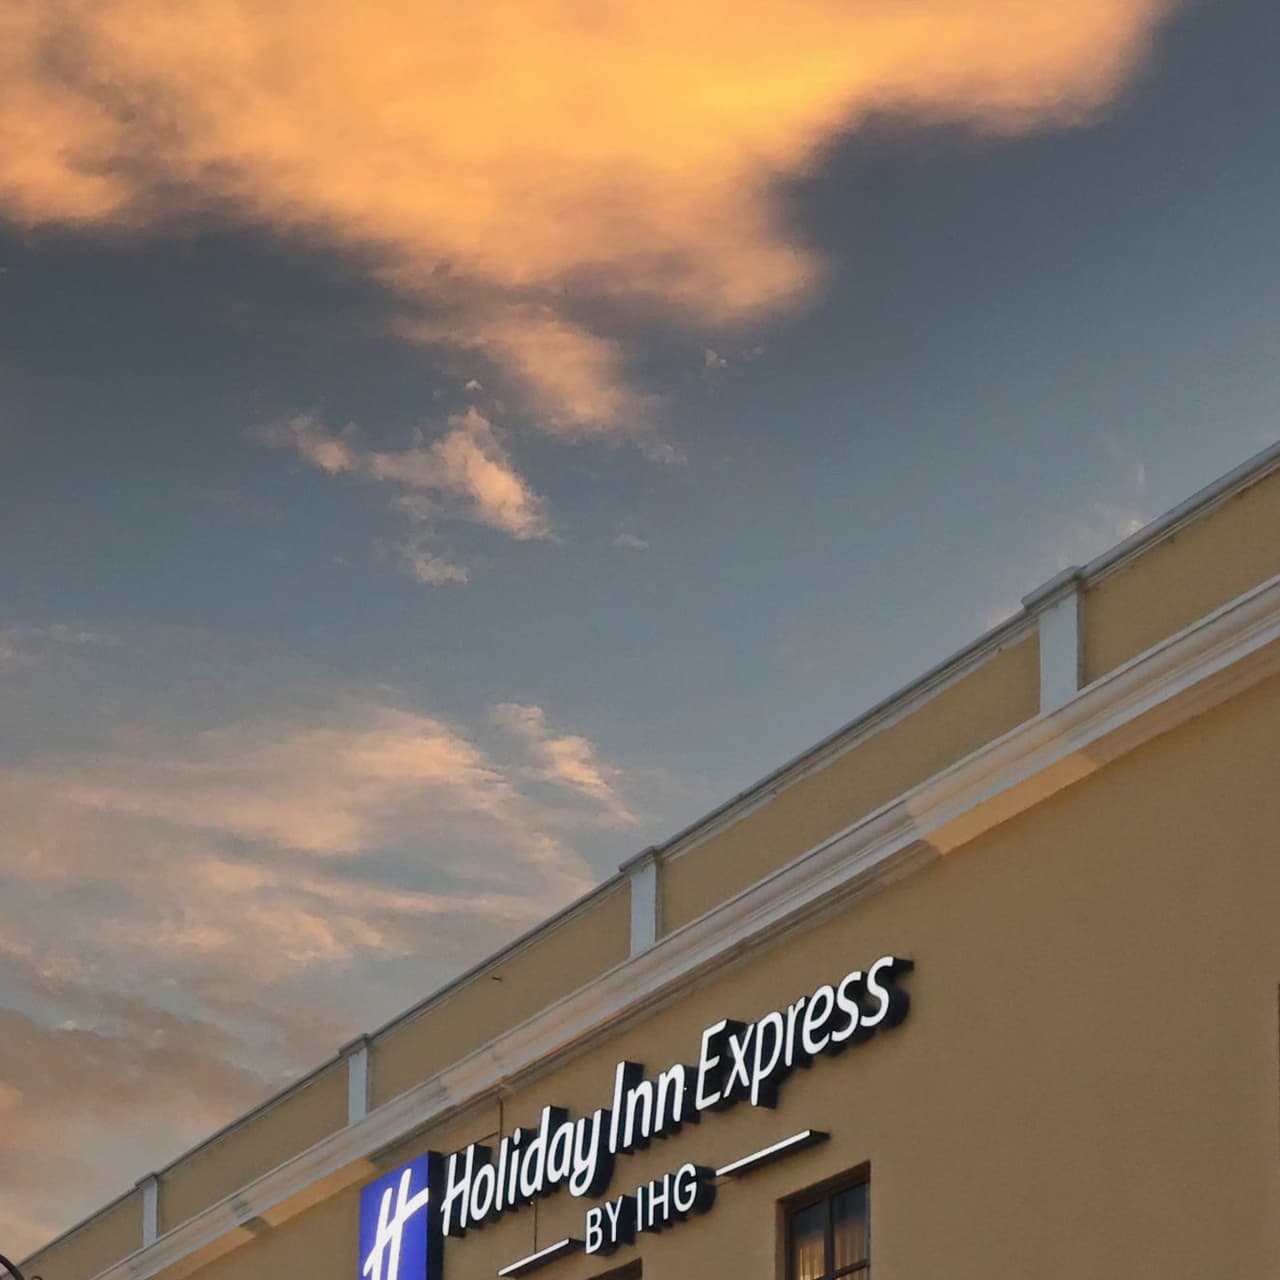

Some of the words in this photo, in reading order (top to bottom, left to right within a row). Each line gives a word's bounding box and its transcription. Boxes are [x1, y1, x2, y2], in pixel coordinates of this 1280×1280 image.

[440, 1106, 602, 1236] Holiday
[609, 1061, 686, 1154] Inn
[695, 956, 895, 1110] Express
[585, 1195, 624, 1254] BY
[637, 1163, 697, 1232] IHG
